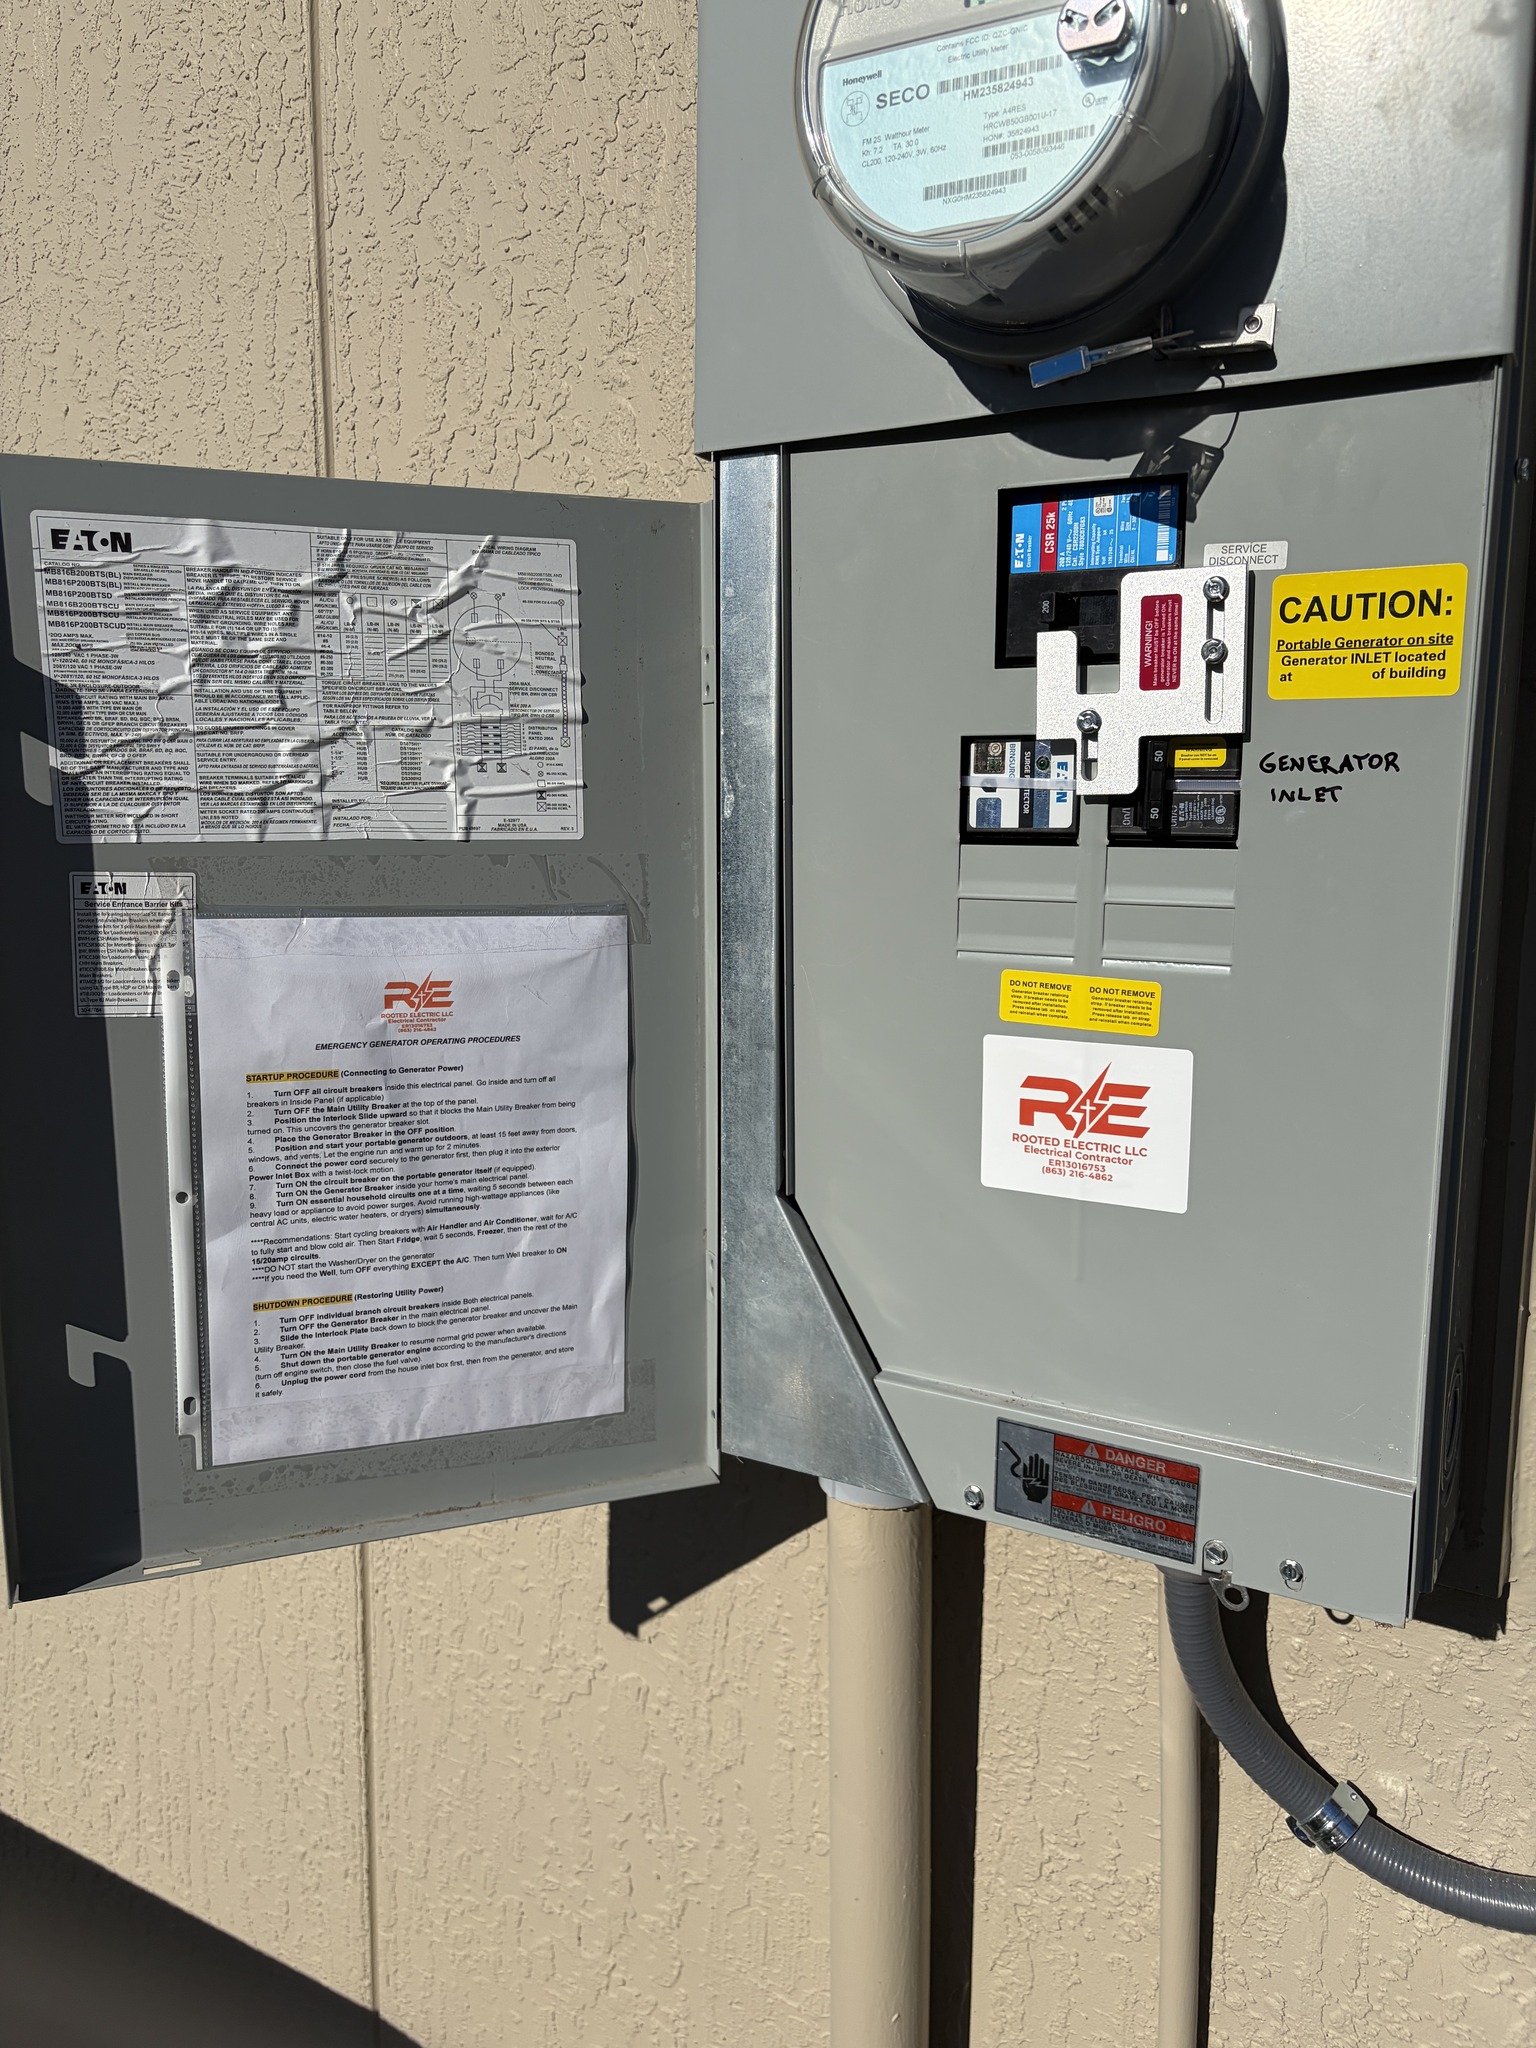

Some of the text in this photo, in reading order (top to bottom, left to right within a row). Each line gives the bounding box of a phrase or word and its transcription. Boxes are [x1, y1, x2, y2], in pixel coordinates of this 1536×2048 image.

[937, 42, 964, 52] Contains
[965, 36, 979, 45] FCC
[948, 44, 1009, 63] Electric Utility Meter
[842, 70, 882, 86] Honeywell
[876, 84, 930, 109] SECO
[963, 77, 1034, 101] HM235824943
[913, 126, 930, 135] Meter
[1045, 512, 1055, 553] CSR 25k
[51, 529, 132, 553] EATON
[1221, 543, 1267, 554] SERVICE
[1015, 533, 1024, 568] EATON
[1209, 555, 1279, 566] DISCONNECT
[44, 569, 122, 580] MB816B200BTS(BL)
[45, 578, 122, 590] MB816P200BTS(BL)
[46, 590, 112, 599] MB816P200BTSD
[47, 610, 120, 618] MB816P200BTSCU
[1279, 588, 1452, 624] CAUTION:
[48, 620, 126, 629] MB816P200BTSCUD
[1144, 621, 1153, 667] WARNING!
[1277, 633, 1454, 650] Portable Generator on site
[1281, 649, 1446, 666] Generator INLET located
[1280, 672, 1293, 682] at
[1372, 666, 1446, 680] of building
[1023, 751, 1031, 773] SURGE
[1154, 750, 1164, 762] 50
[1259, 752, 1400, 774] GENERATOR
[1270, 786, 1342, 803] INLET
[1151, 807, 1159, 820] 50
[85, 900, 111, 908] Service
[1039, 982, 1072, 991] REMOVE
[1121, 989, 1155, 998] REMOVE
[315, 1035, 520, 1050] EMERGENCY GENERATOR OPERATING PROCEDURES
[246, 1074, 284, 1082] STARTUP
[287, 1071, 338, 1081] PROCEDURE
[341, 1069, 387, 1079] (Connecting
[398, 1066, 436, 1074] Generator
[292, 1087, 310, 1097] OFF
[350, 1085, 383, 1093] breakers
[384, 1082, 405, 1091] inside
[421, 1081, 452, 1089] electrical
[453, 1080, 474, 1088] panel.
[458, 1098, 478, 1106] panel.
[1012, 1133, 1147, 1157] ROOTED ELECTRIC LLC
[1024, 1145, 1133, 1165] Electrical Contractor
[1042, 1166, 1113, 1182] (863) 216-4862
[1049, 1159, 1106, 1173] ER13016753
[253, 1300, 300, 1311] SHUTDOWN
[302, 1294, 352, 1305] PROCEDURE
[354, 1292, 393, 1301] (Restoring
[419, 1286, 443, 1294] Power)
[1055, 1458, 1081, 1467] SEVERE
[1084, 1465, 1109, 1474] INJURY
[1105, 1449, 1166, 1473] DANGER
[1055, 1452, 1101, 1466] HAZARDOUS
[1170, 1479, 1196, 1489] CAUSE
[1102, 1507, 1166, 1532] PELIGRO
